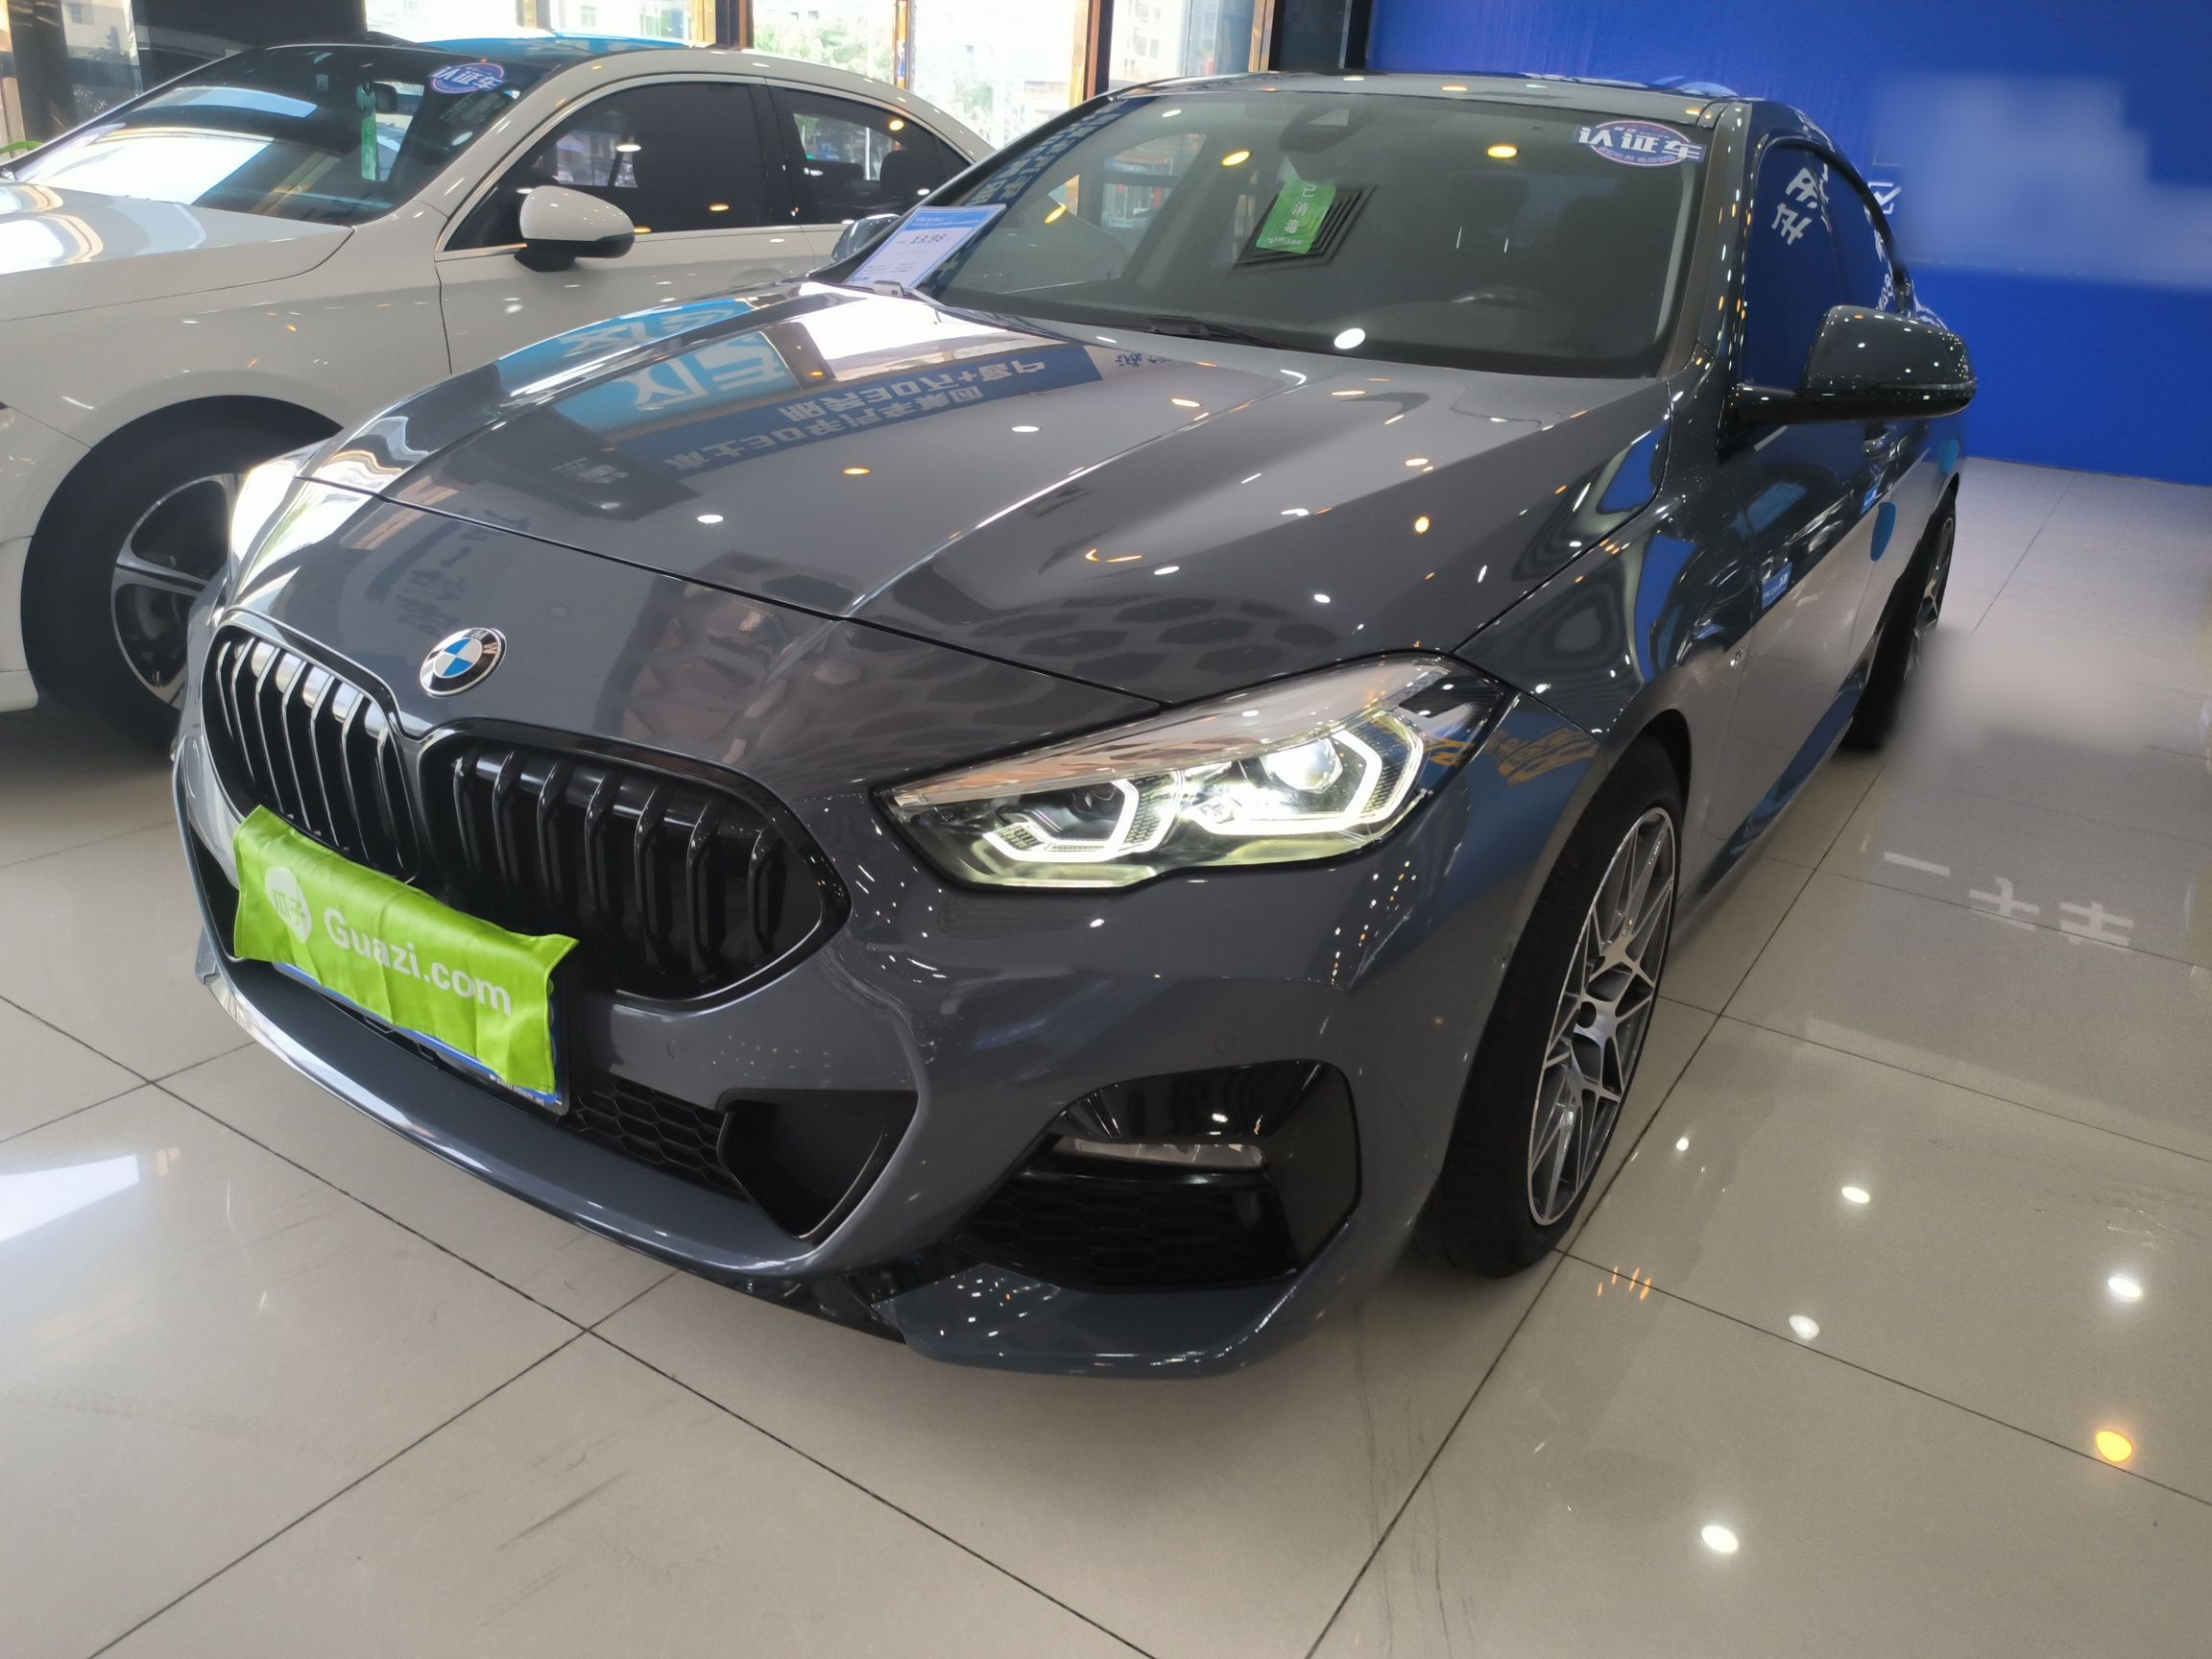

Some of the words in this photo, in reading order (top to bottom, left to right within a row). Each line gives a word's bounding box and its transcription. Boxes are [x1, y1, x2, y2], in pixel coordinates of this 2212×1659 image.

[432, 66, 504, 89] 认证车
[1577, 126, 1702, 160] 认证车
[324, 907, 513, 1017] Guazi.com
